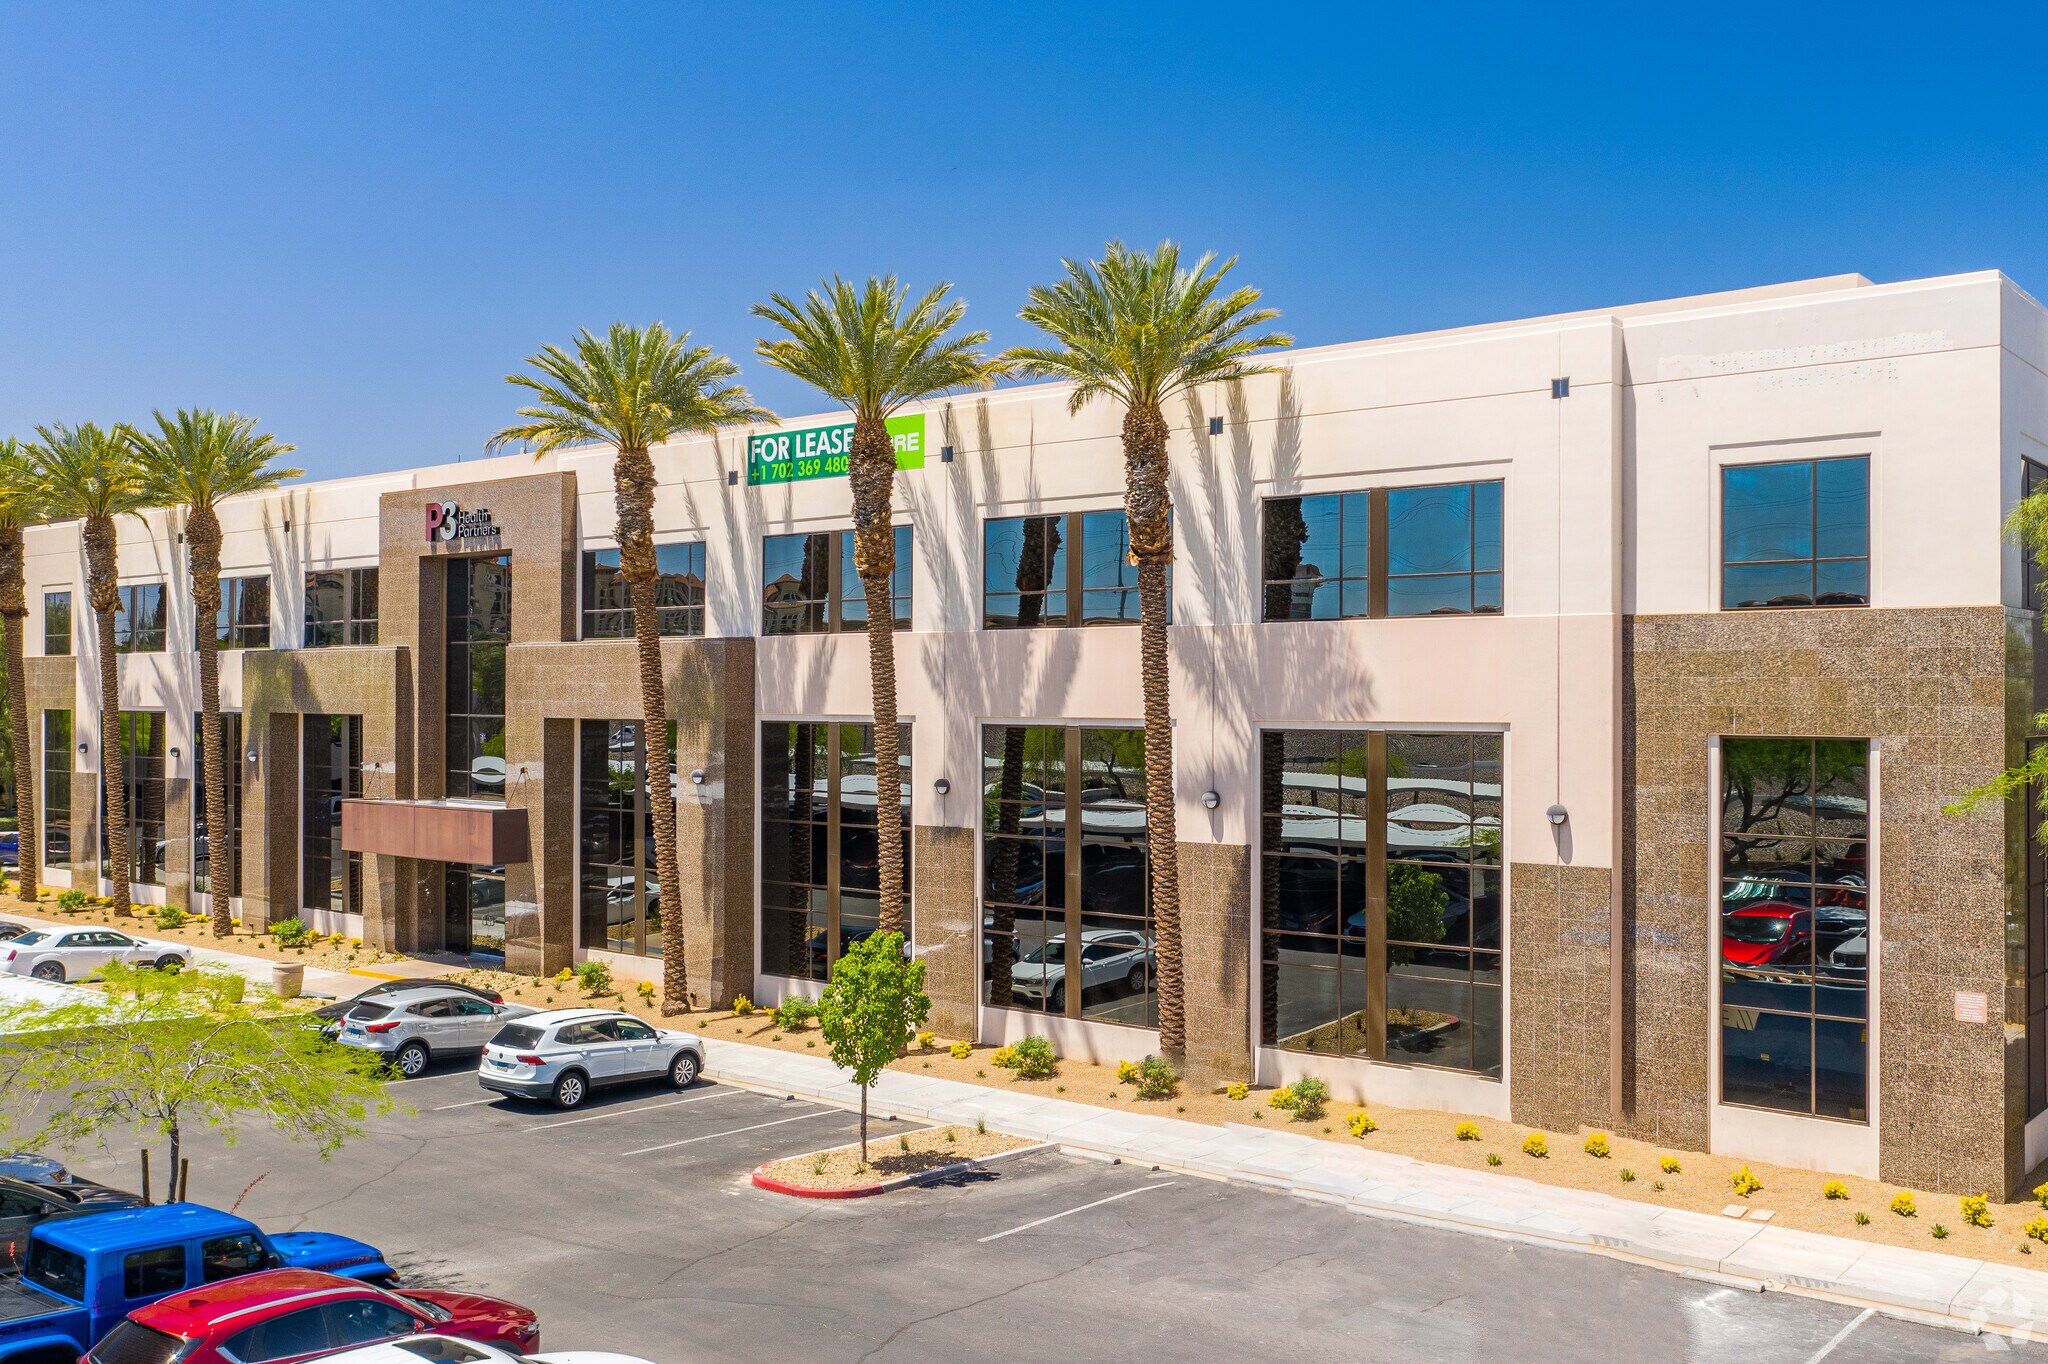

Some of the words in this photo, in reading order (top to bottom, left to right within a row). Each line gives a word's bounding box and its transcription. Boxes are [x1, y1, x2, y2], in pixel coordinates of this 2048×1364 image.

[751, 436, 790, 463] FOR
[795, 428, 854, 458] LEASE
[751, 465, 766, 480] +1
[771, 462, 794, 480] 702
[797, 459, 821, 477] 369
[426, 500, 458, 542] P3
[458, 508, 488, 524] Health
[458, 524, 497, 537] Partners
